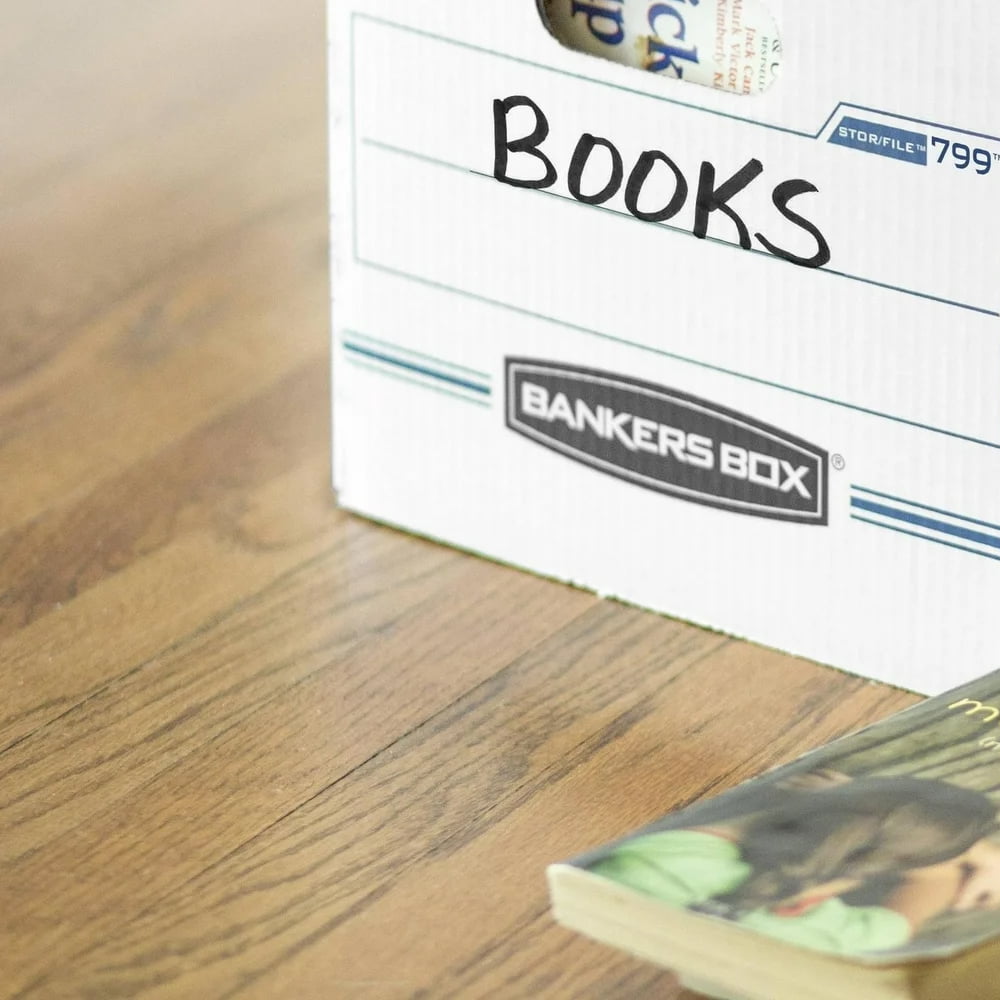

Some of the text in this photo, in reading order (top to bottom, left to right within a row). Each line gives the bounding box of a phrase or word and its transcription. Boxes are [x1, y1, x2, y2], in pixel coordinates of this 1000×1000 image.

[728, 41, 743, 90] Victor
[743, 26, 757, 60] Jack
[493, 95, 831, 268] BOOKS
[521, 381, 715, 470] BANKERS
[719, 442, 812, 499] BOX
